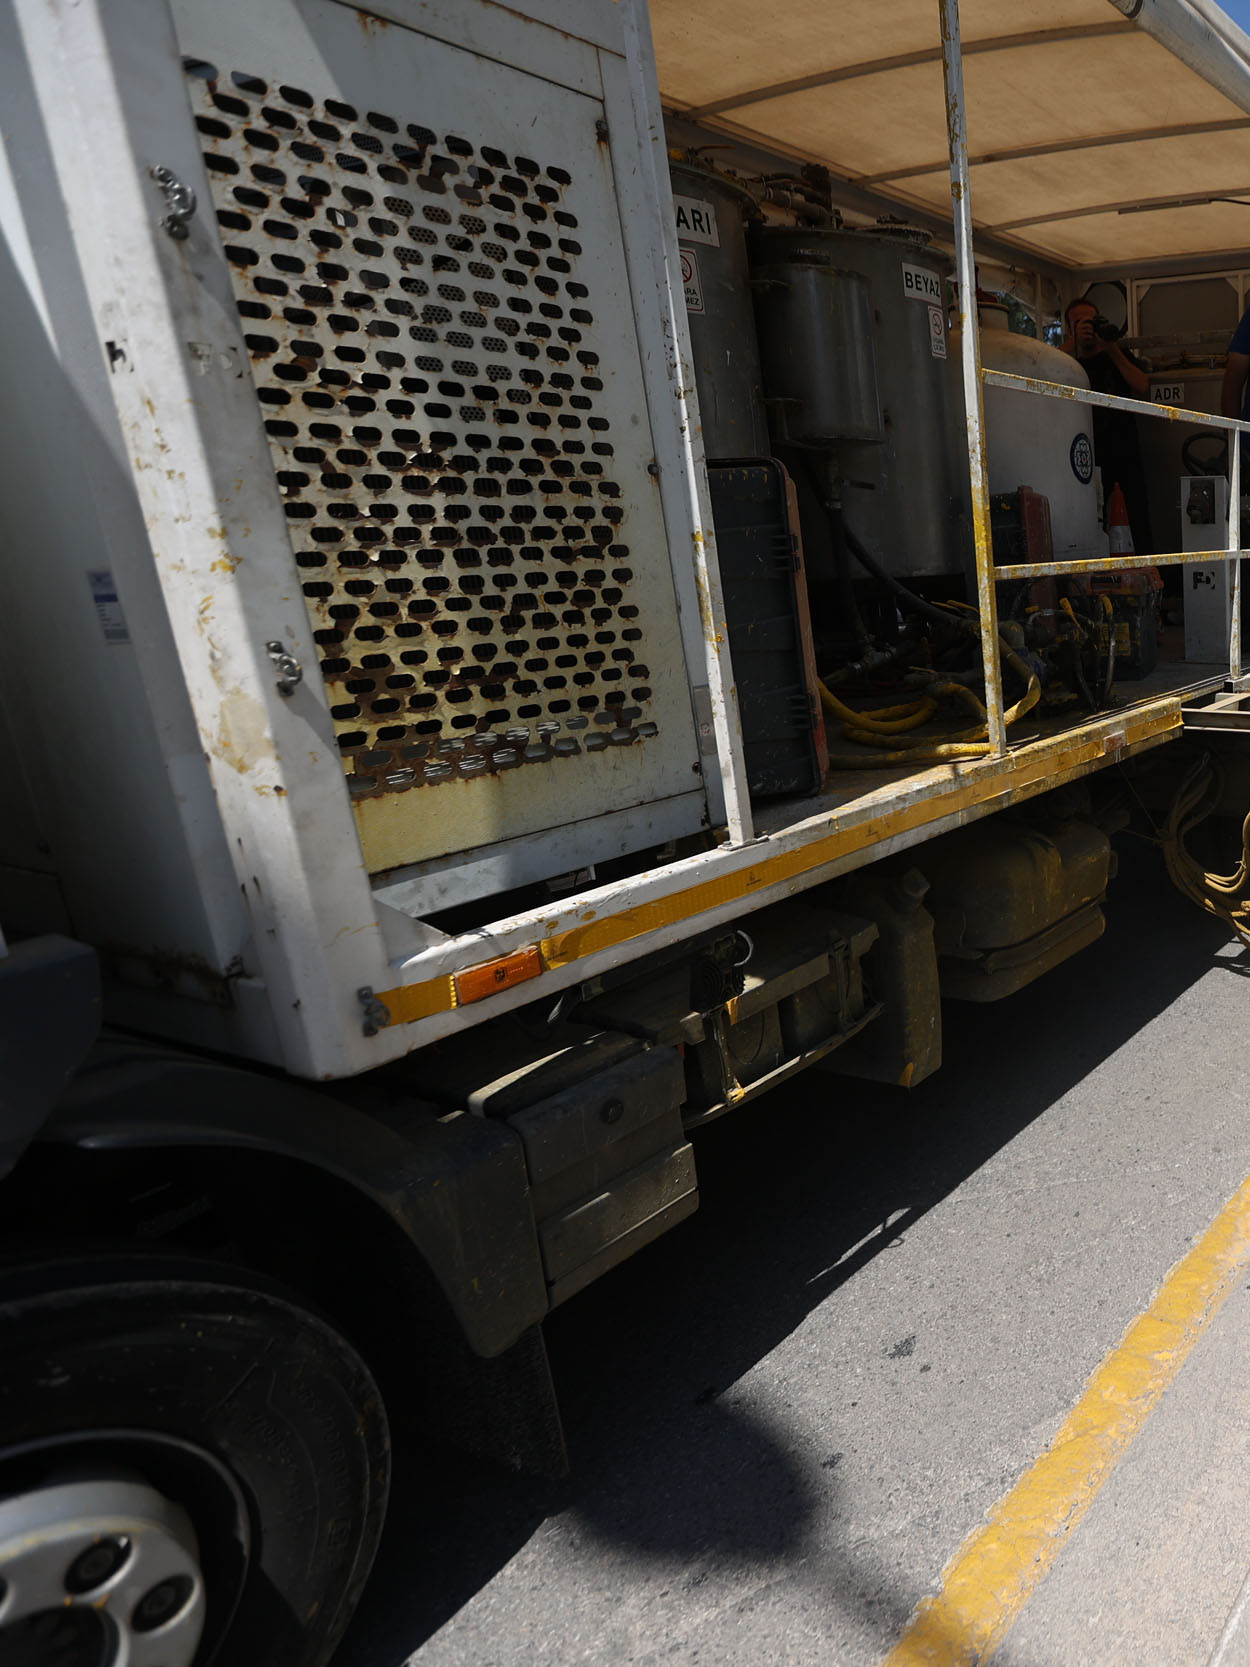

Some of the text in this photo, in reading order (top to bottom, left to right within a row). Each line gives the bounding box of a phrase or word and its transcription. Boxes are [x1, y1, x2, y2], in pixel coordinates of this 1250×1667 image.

[676, 206, 712, 235] ARI
[905, 271, 941, 298] BEYAZ
[1154, 387, 1181, 401] ADR
